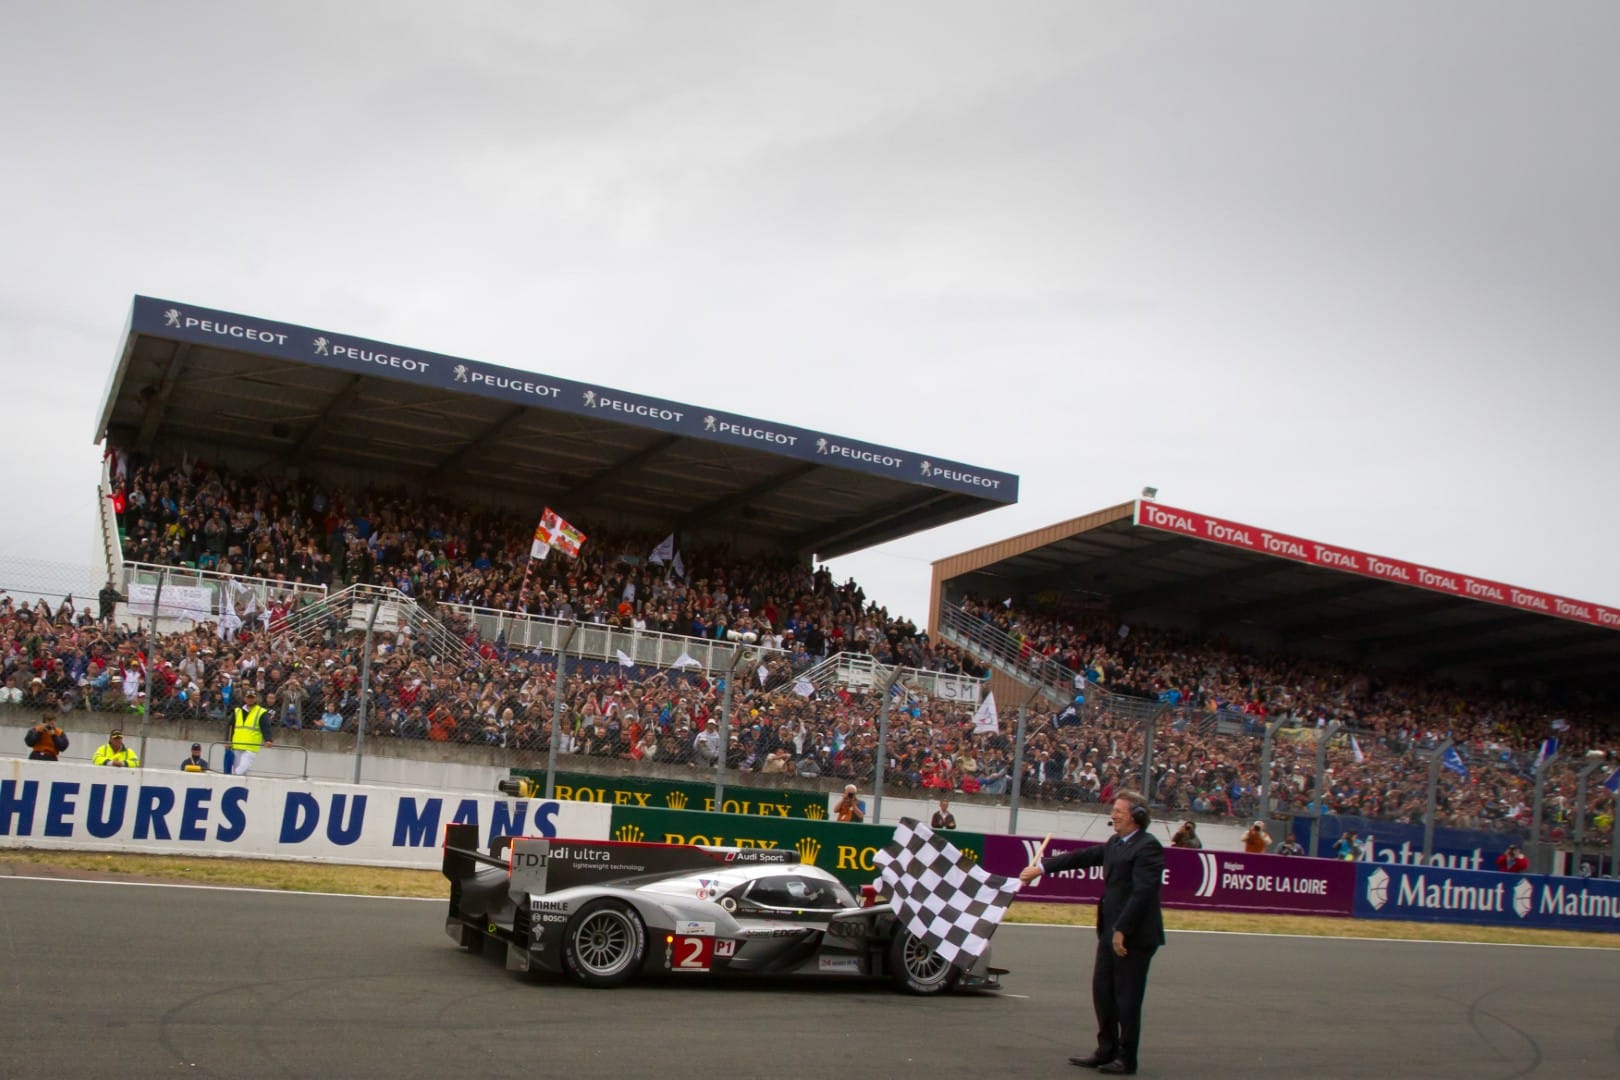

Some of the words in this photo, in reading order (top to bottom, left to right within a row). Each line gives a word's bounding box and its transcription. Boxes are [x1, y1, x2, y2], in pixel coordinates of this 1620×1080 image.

[185, 316, 288, 345] PEUGEOT
[333, 344, 430, 373] PEUGEOT
[470, 371, 561, 398] PEUGEOT
[600, 397, 684, 423] PEUGEOT
[719, 422, 798, 447] PEUGEOT
[830, 444, 903, 469] PEUGEOT
[933, 467, 1001, 490] PEUGEOT
[1145, 505, 1197, 532] TOTAL
[1204, 519, 1254, 545] TOTAL
[1260, 533, 1308, 559] TOTAL
[1313, 544, 1360, 570] TOTAL
[1366, 557, 1411, 581] TOTAL
[1416, 568, 1459, 592] TOTAL
[1463, 579, 1504, 601] TOTAL
[1510, 589, 1549, 610] TOTAL
[1554, 599, 1591, 619] TOTAL
[555, 784, 652, 808] ROLEX
[0, 779, 249, 842] HEURES
[278, 791, 368, 846] DU
[392, 796, 560, 848] MANS
[514, 853, 547, 868] TDI
[572, 861, 609, 871] lightweight
[610, 864, 645, 872] technology
[573, 848, 611, 861] ultra
[737, 852, 757, 861] Audi
[759, 853, 784, 862] Sport
[1222, 873, 1254, 891] PAYS
[1256, 875, 1273, 892] DE
[1275, 876, 1291, 893] LA
[1293, 878, 1328, 895] LOIRE
[1397, 873, 1505, 912] Matmut
[532, 900, 569, 911] MAHLE
[542, 914, 568, 923] BOSCH
[680, 937, 703, 968] 2
[716, 941, 732, 953] P1
